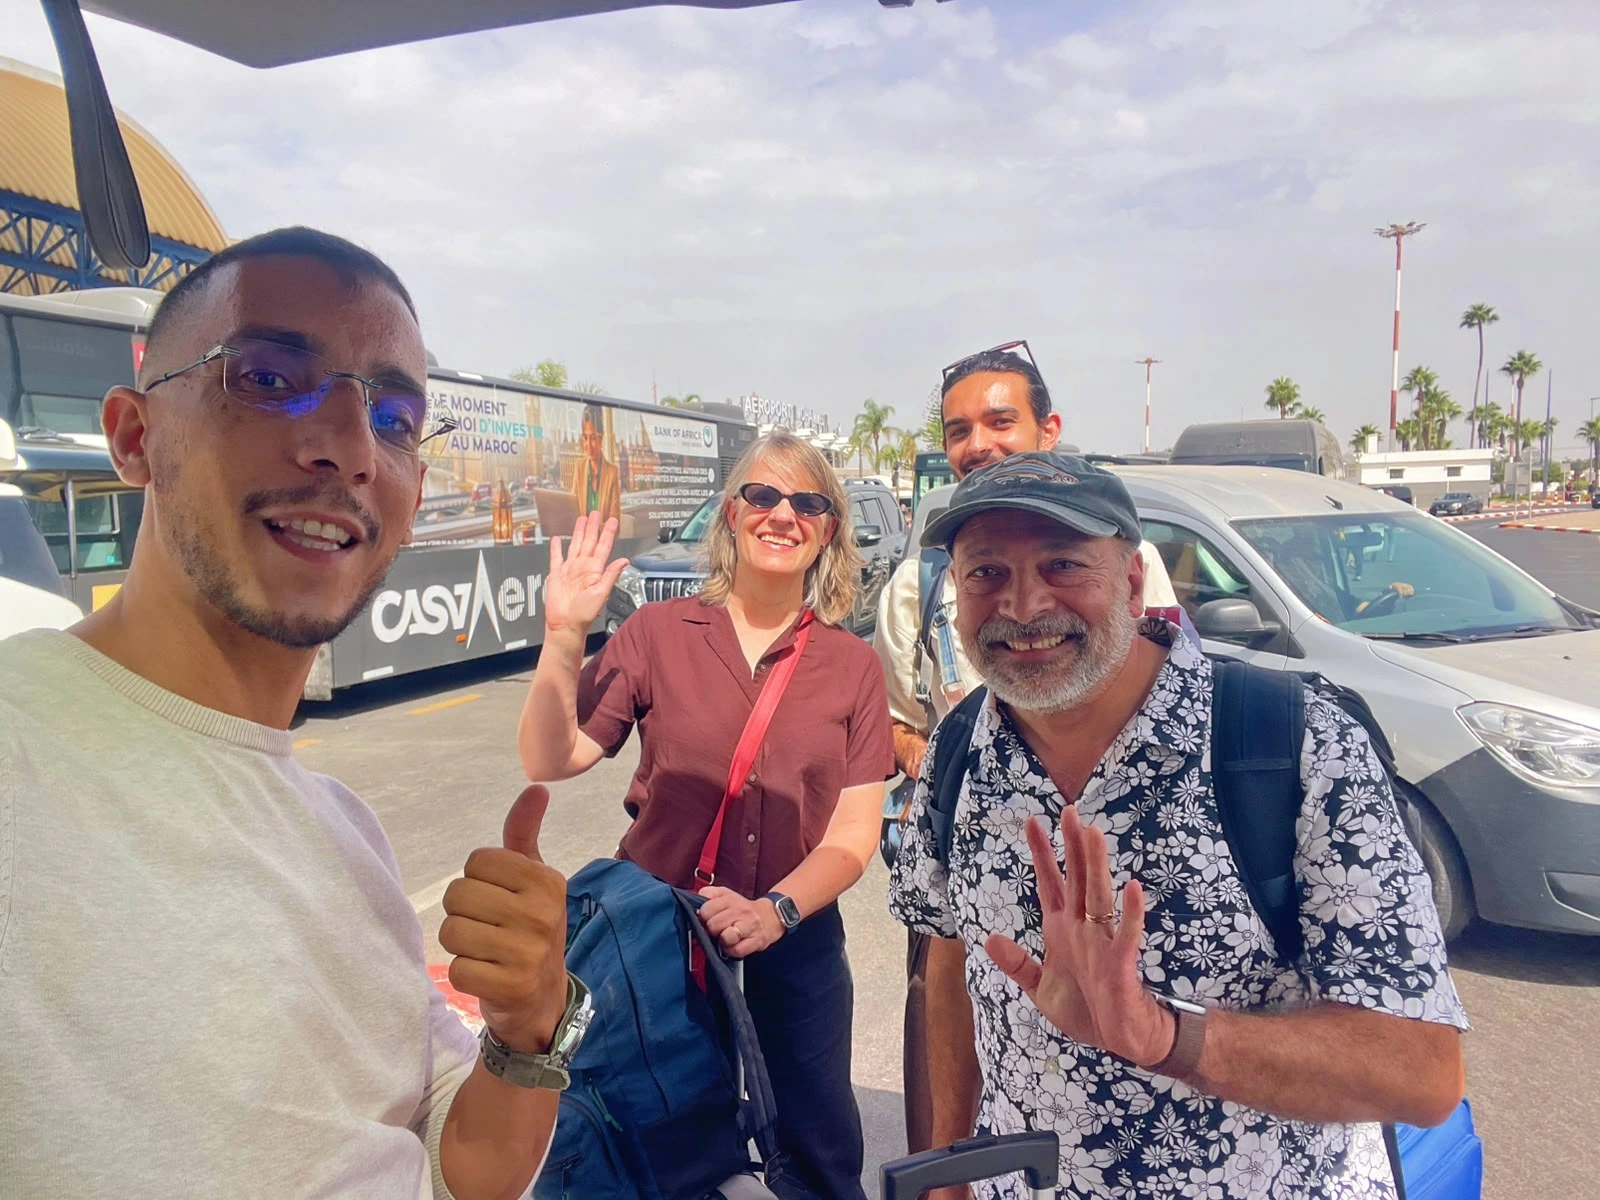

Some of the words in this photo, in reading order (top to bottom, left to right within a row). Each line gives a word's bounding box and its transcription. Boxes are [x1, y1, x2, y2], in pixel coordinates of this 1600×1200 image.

[451, 395, 507, 416] MOMENT
[480, 417, 544, 439] D'INVESTIR
[654, 426, 672, 437] BANK
[673, 428, 681, 438] OF
[682, 430, 702, 441] AFRICA
[450, 435, 470, 451] AU
[473, 437, 518, 455] MAROC
[466, 548, 549, 650] Aer
